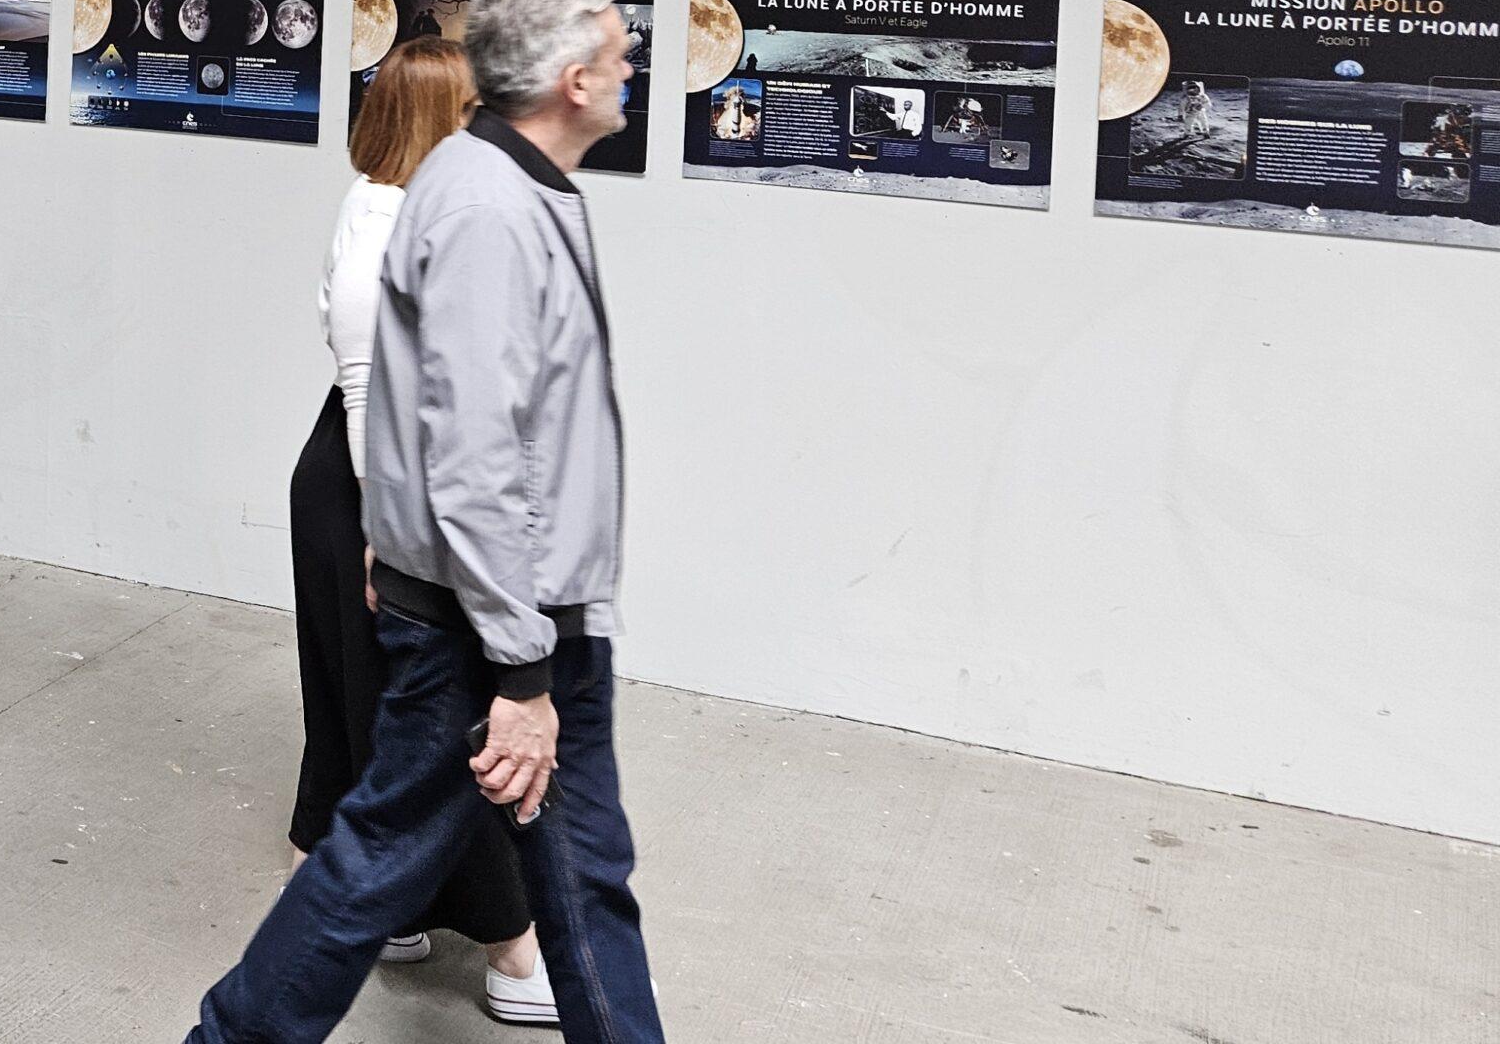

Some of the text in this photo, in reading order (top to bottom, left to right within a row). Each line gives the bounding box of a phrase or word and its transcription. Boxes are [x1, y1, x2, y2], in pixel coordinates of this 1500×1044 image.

[930, 1, 1024, 18] D'HOMME
[878, 16, 887, 25] V
[887, 17, 898, 26] et
[900, 17, 928, 29] Eagle
[1184, 11, 1211, 26] LA
[1217, 12, 1275, 28] LUNE
[1280, 11, 1296, 29] À
[1302, 14, 1391, 33] PORTÉE
[1316, 34, 1371, 47] Apollo 11
